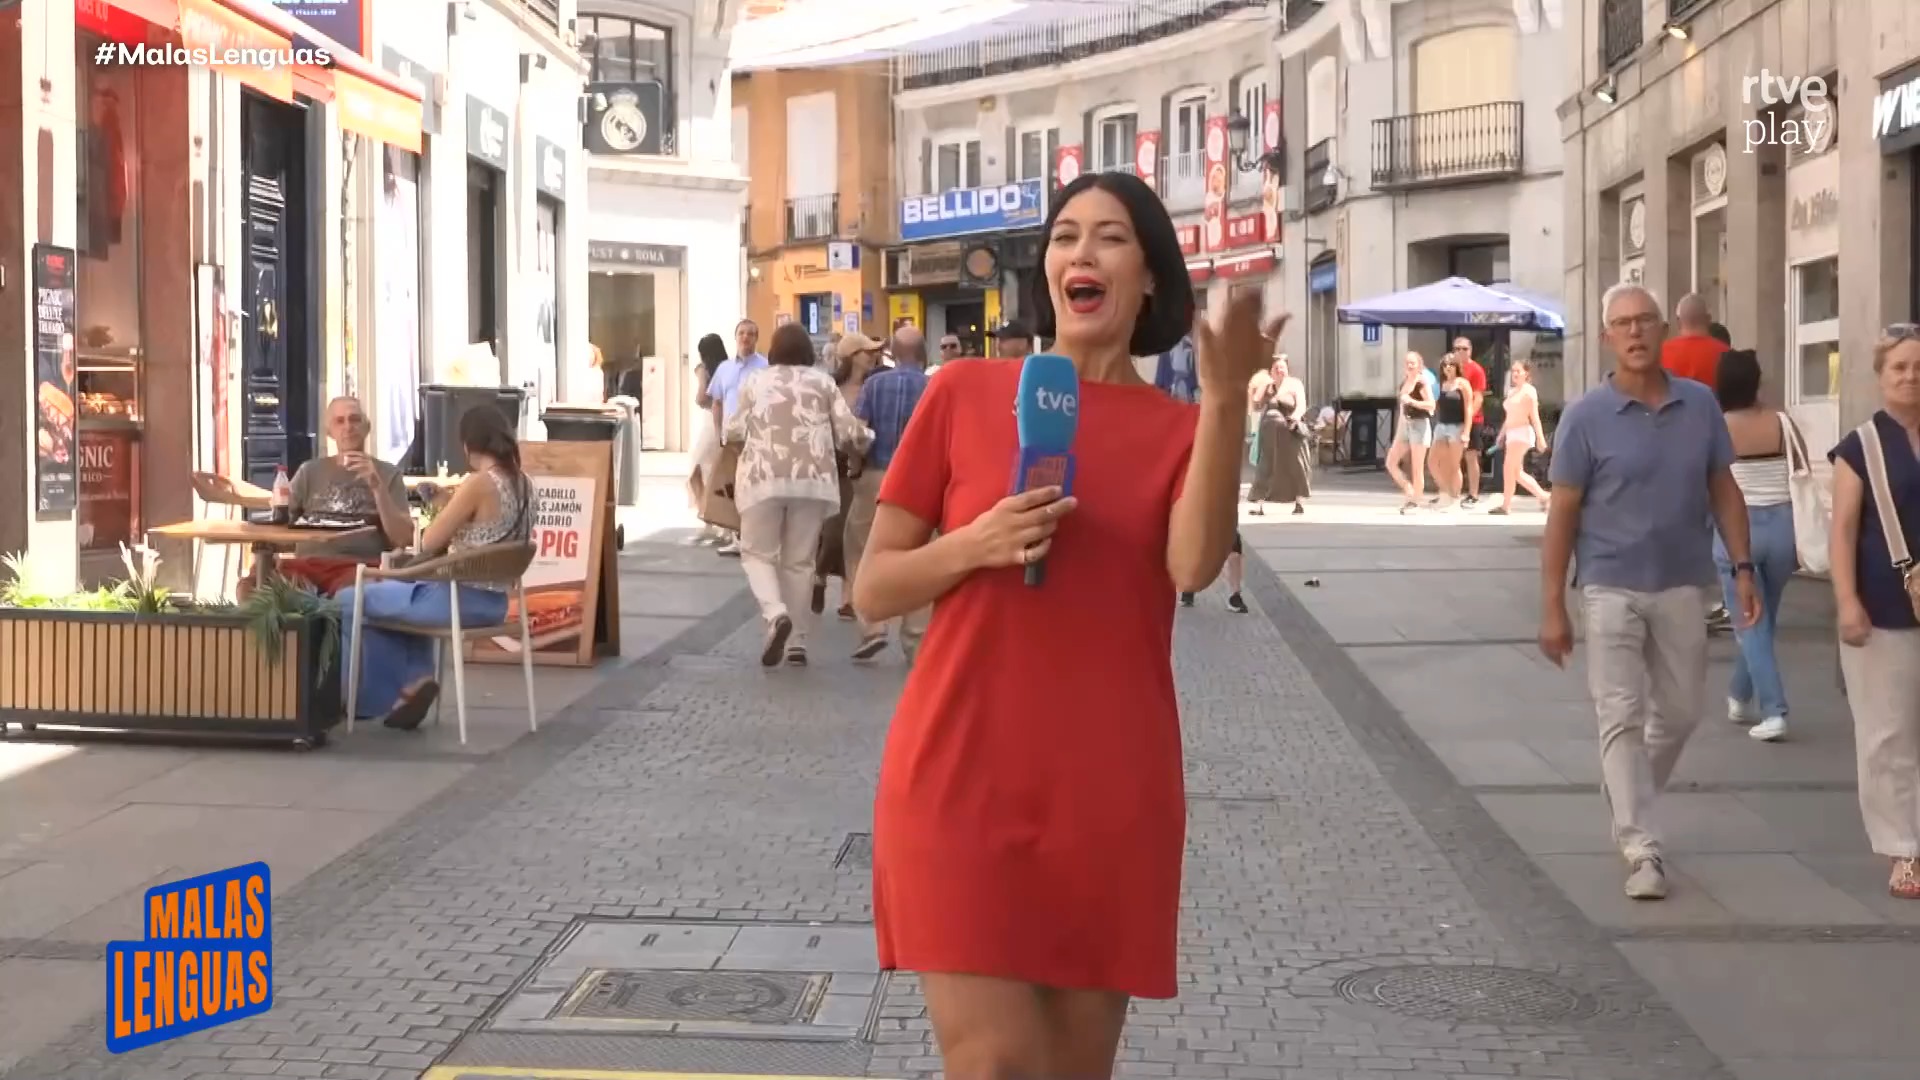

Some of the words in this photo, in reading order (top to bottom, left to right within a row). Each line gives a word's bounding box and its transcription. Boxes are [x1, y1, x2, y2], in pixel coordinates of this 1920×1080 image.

[903, 184, 1021, 224] BELLIDO
[635, 249, 665, 263] ROMA
[1036, 387, 1076, 416] tve
[548, 501, 582, 513] JAMÓN
[541, 530, 578, 558] PIG
